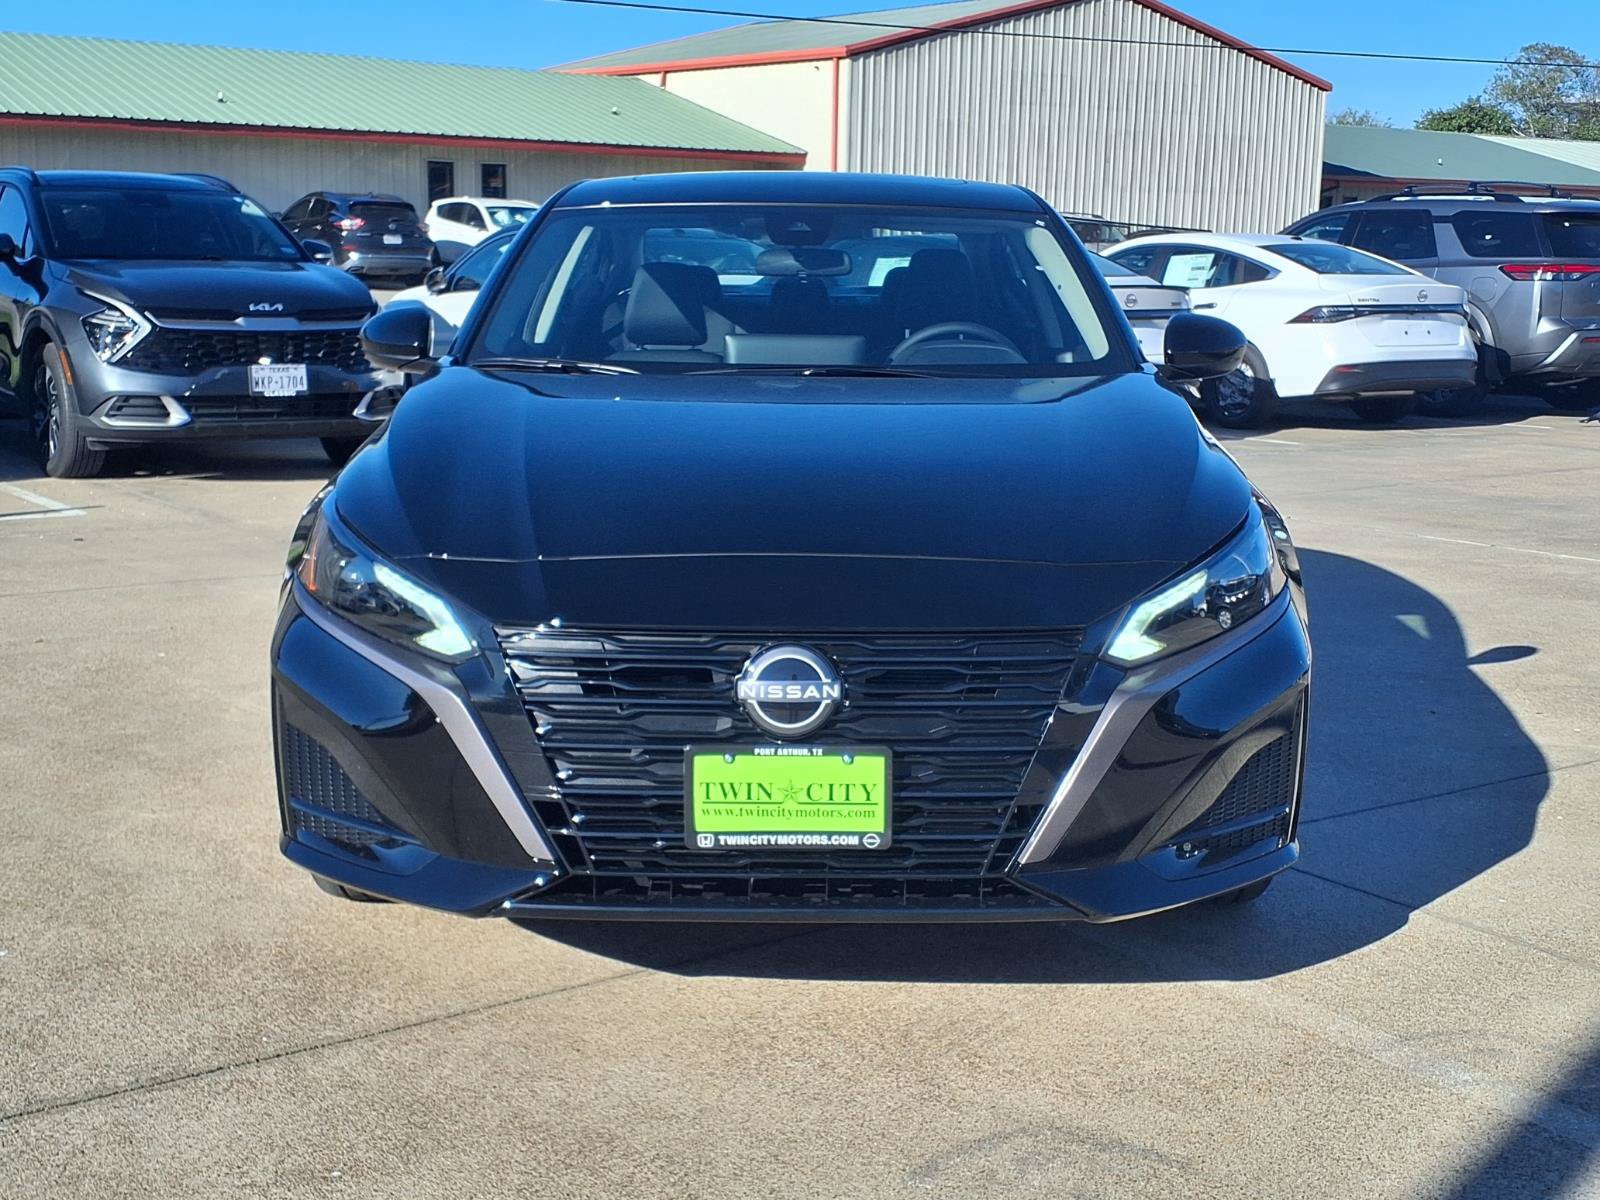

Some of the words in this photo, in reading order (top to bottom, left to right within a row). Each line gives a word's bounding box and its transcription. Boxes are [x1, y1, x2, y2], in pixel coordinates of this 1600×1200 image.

[739, 684, 839, 699] NISSAN
[754, 748, 776, 756] PORT
[811, 748, 823, 756] TX
[700, 782, 773, 801] TWIN
[805, 782, 877, 802] CITY
[701, 805, 876, 820] www.twincitymotors.com
[717, 835, 859, 846] TWINCITYMOTORS.COM
